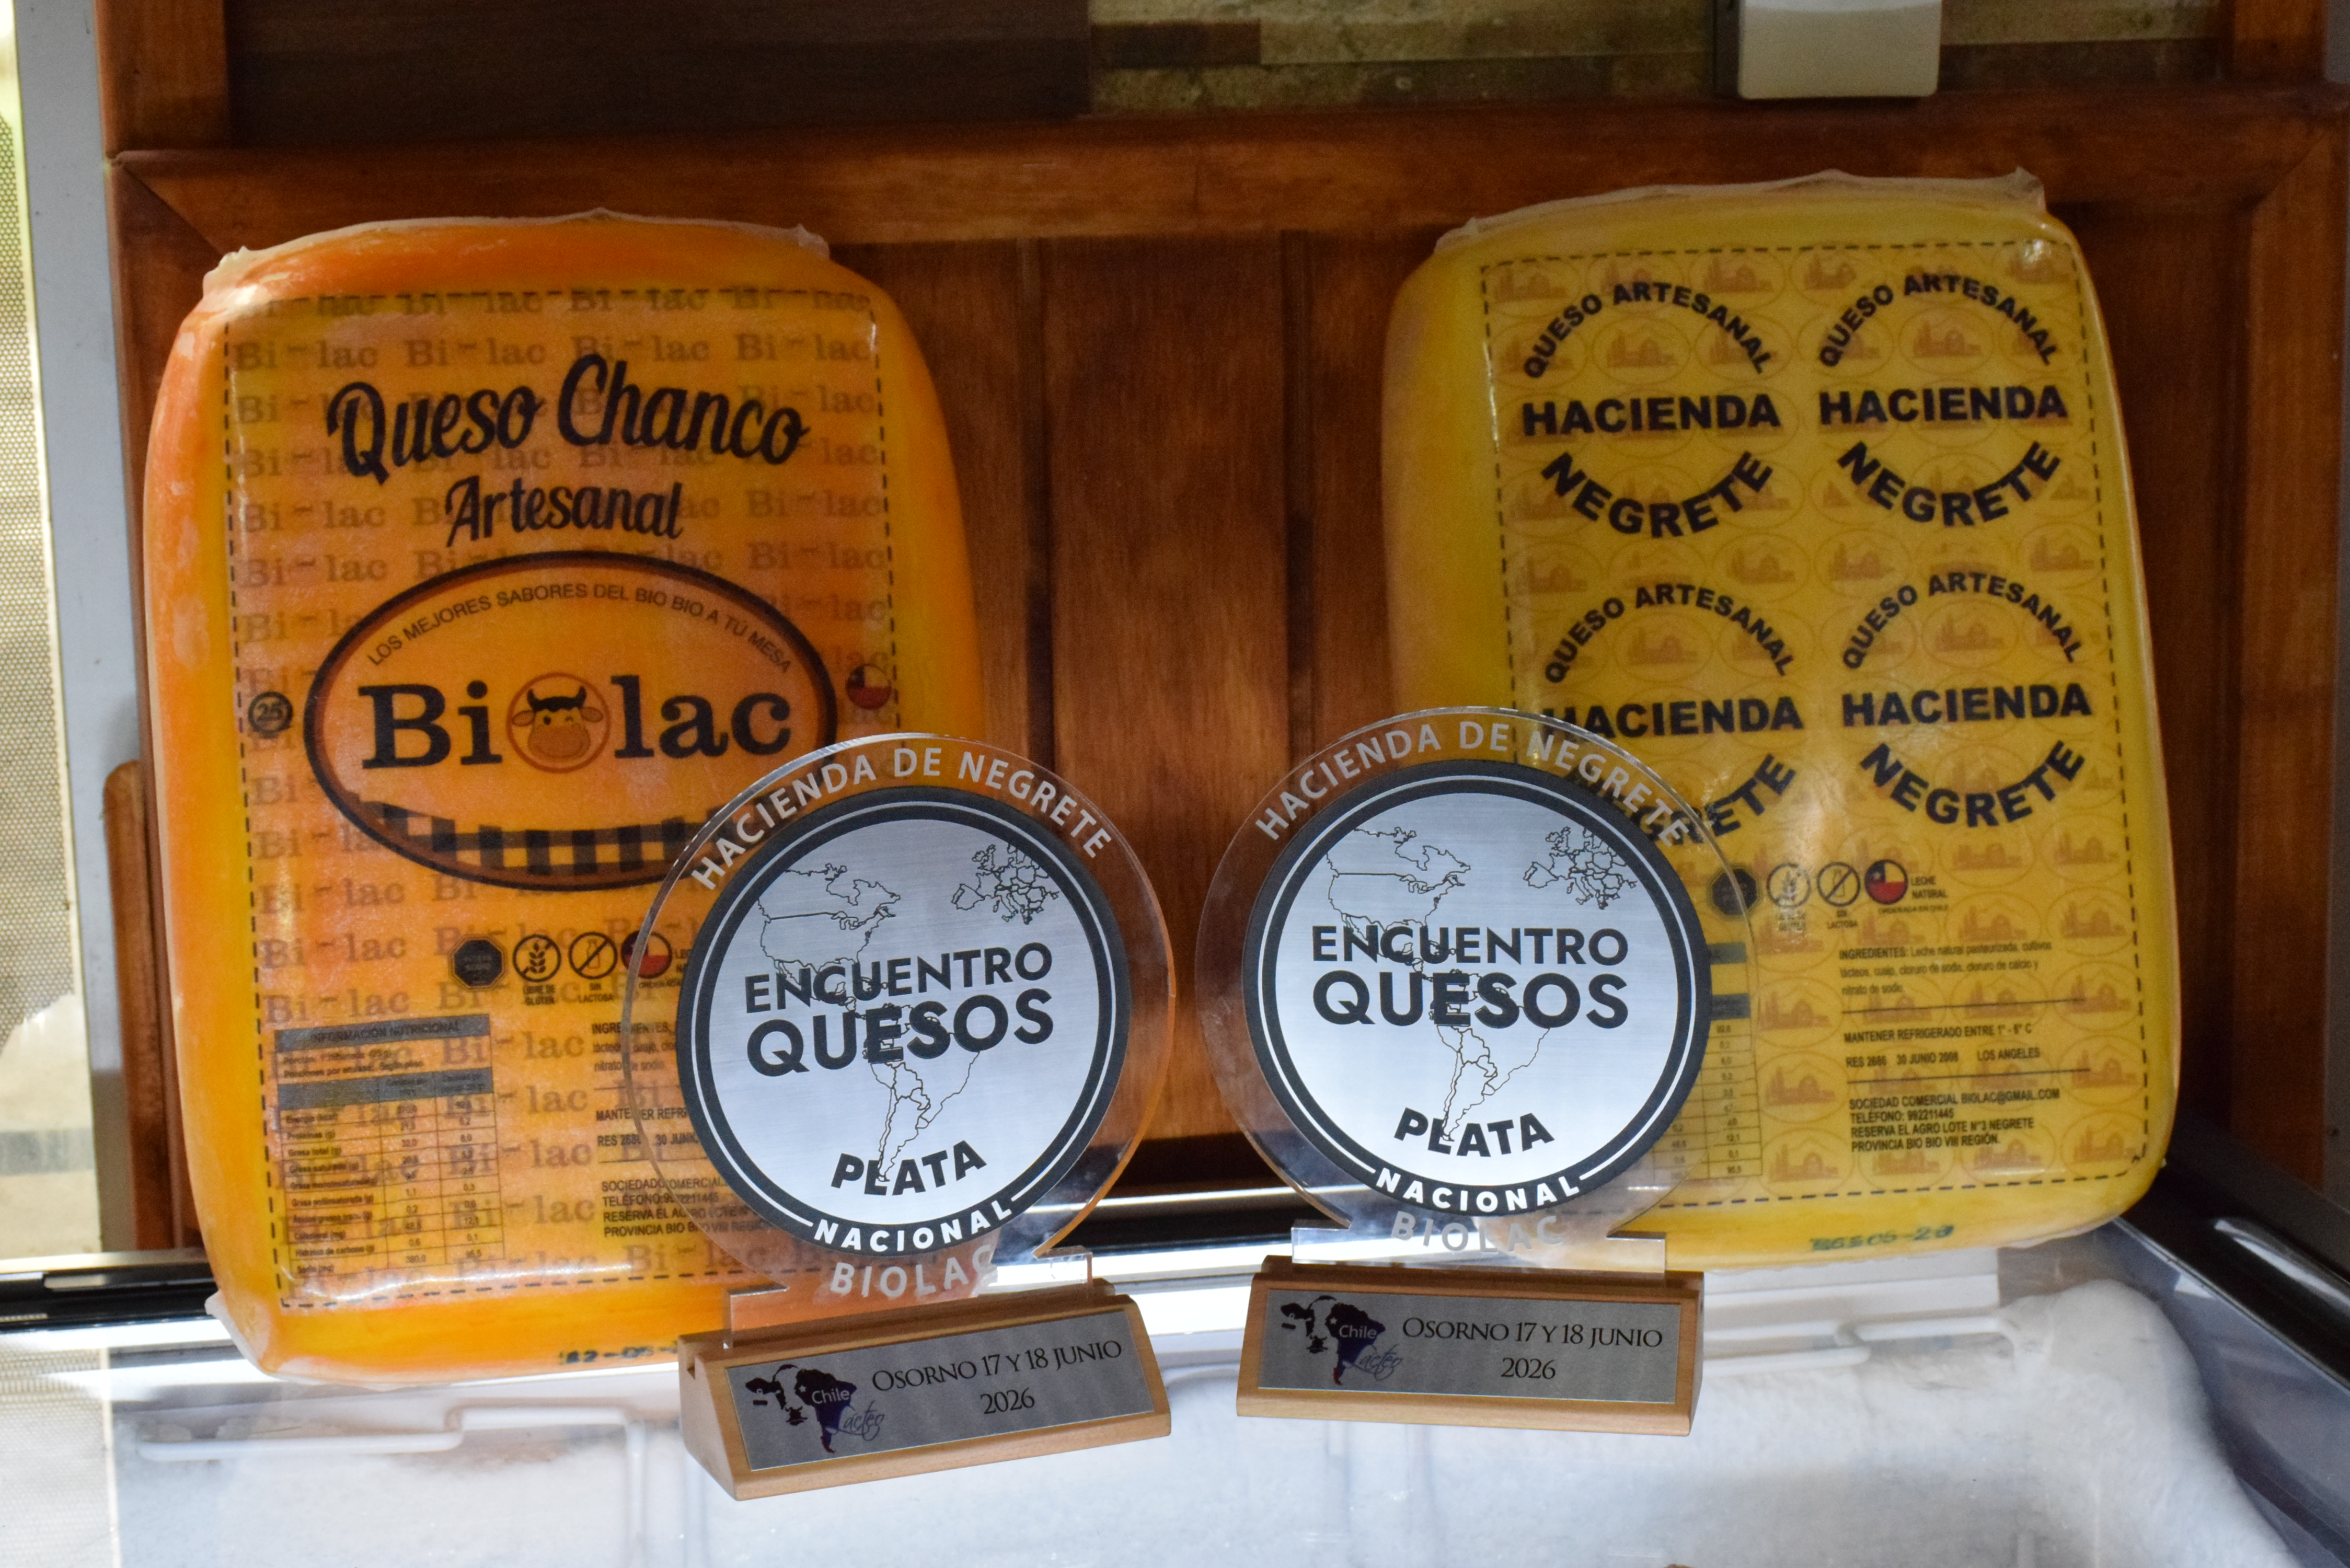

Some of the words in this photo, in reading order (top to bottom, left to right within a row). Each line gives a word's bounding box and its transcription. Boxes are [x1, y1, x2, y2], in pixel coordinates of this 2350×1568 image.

[1523, 294, 1602, 378] QUESO
[1613, 281, 1772, 374] ARTESANAL
[1818, 284, 1894, 367] QUESO
[1904, 273, 2057, 366] ARTESANAL
[325, 381, 547, 487] Queso
[557, 353, 810, 465] Chanco
[1522, 393, 1781, 436] HACIENDA
[1818, 385, 2069, 425] HACIENDA
[1541, 451, 1773, 538] NEGRETE
[1837, 441, 2061, 527] NEGRETE
[444, 474, 684, 549] Artesanal
[366, 634, 404, 666] LOS
[402, 596, 492, 641] MEJORES
[496, 583, 588, 608] SABORES
[593, 584, 629, 600] DEL
[635, 586, 666, 607] BIO
[671, 596, 705, 621] BIO
[706, 607, 720, 623] A
[747, 630, 793, 673] MESA
[1545, 597, 1624, 684] QUESO
[1635, 583, 1794, 676] ARTESANAL
[1842, 584, 1918, 670] QUESO
[1928, 571, 2082, 663] ARTESANAL
[1841, 683, 2092, 727] HACIENDA
[1255, 723, 1442, 840] HACIENDA
[1459, 720, 1511, 753] DE
[1526, 730, 1691, 848] NEGRETE
[1859, 740, 2086, 828] NEGRETE
[690, 754, 878, 890] HACIENDA
[894, 748, 941, 778] DE
[958, 751, 1112, 858] NEGRETE
[1312, 924, 1629, 966] ENCUENTRO
[745, 942, 1053, 1014] ENCUENTRO
[1312, 970, 1629, 1030] QUESOS
[746, 988, 1054, 1078] QUESOS
[1844, 1029, 1895, 1043] MANTENER
[1849, 1097, 1899, 1111] SOCIEDAD
[1902, 1094, 1958, 1109] COMERCIAL
[1851, 1124, 1896, 1139] RESERVA
[1898, 1124, 1911, 1136] EL
[1912, 1122, 1941, 1136] AGRO
[1942, 1121, 1967, 1133] LOTE
[1989, 1116, 2035, 1131] NEGRETE
[1394, 1106, 1555, 1158] PLATA
[1851, 1138, 1904, 1153] PROVINCIA
[1906, 1137, 1923, 1149] BIO
[1925, 1136, 1942, 1148] BIO
[830, 1139, 987, 1196] PLATA
[1375, 1167, 1580, 1213] NACIONAL
[814, 1198, 1011, 1252] NACIONAL
[1390, 1210, 1564, 1255] BIOLAC
[1339, 1324, 1377, 1339] Chile
[1514, 1321, 1537, 1342] 17
[1540, 1326, 1558, 1344] Y
[1563, 1324, 1584, 1344] 18
[1588, 1328, 1663, 1349] JUNIO
[980, 1355, 1003, 1377] 17
[1005, 1353, 1022, 1374] Y
[1025, 1348, 1050, 1371] 18
[1053, 1340, 1122, 1372] JUNIO
[1500, 1357, 1557, 1380] 2026
[811, 1388, 850, 1405] Chile
[981, 1392, 1036, 1415] 2026
